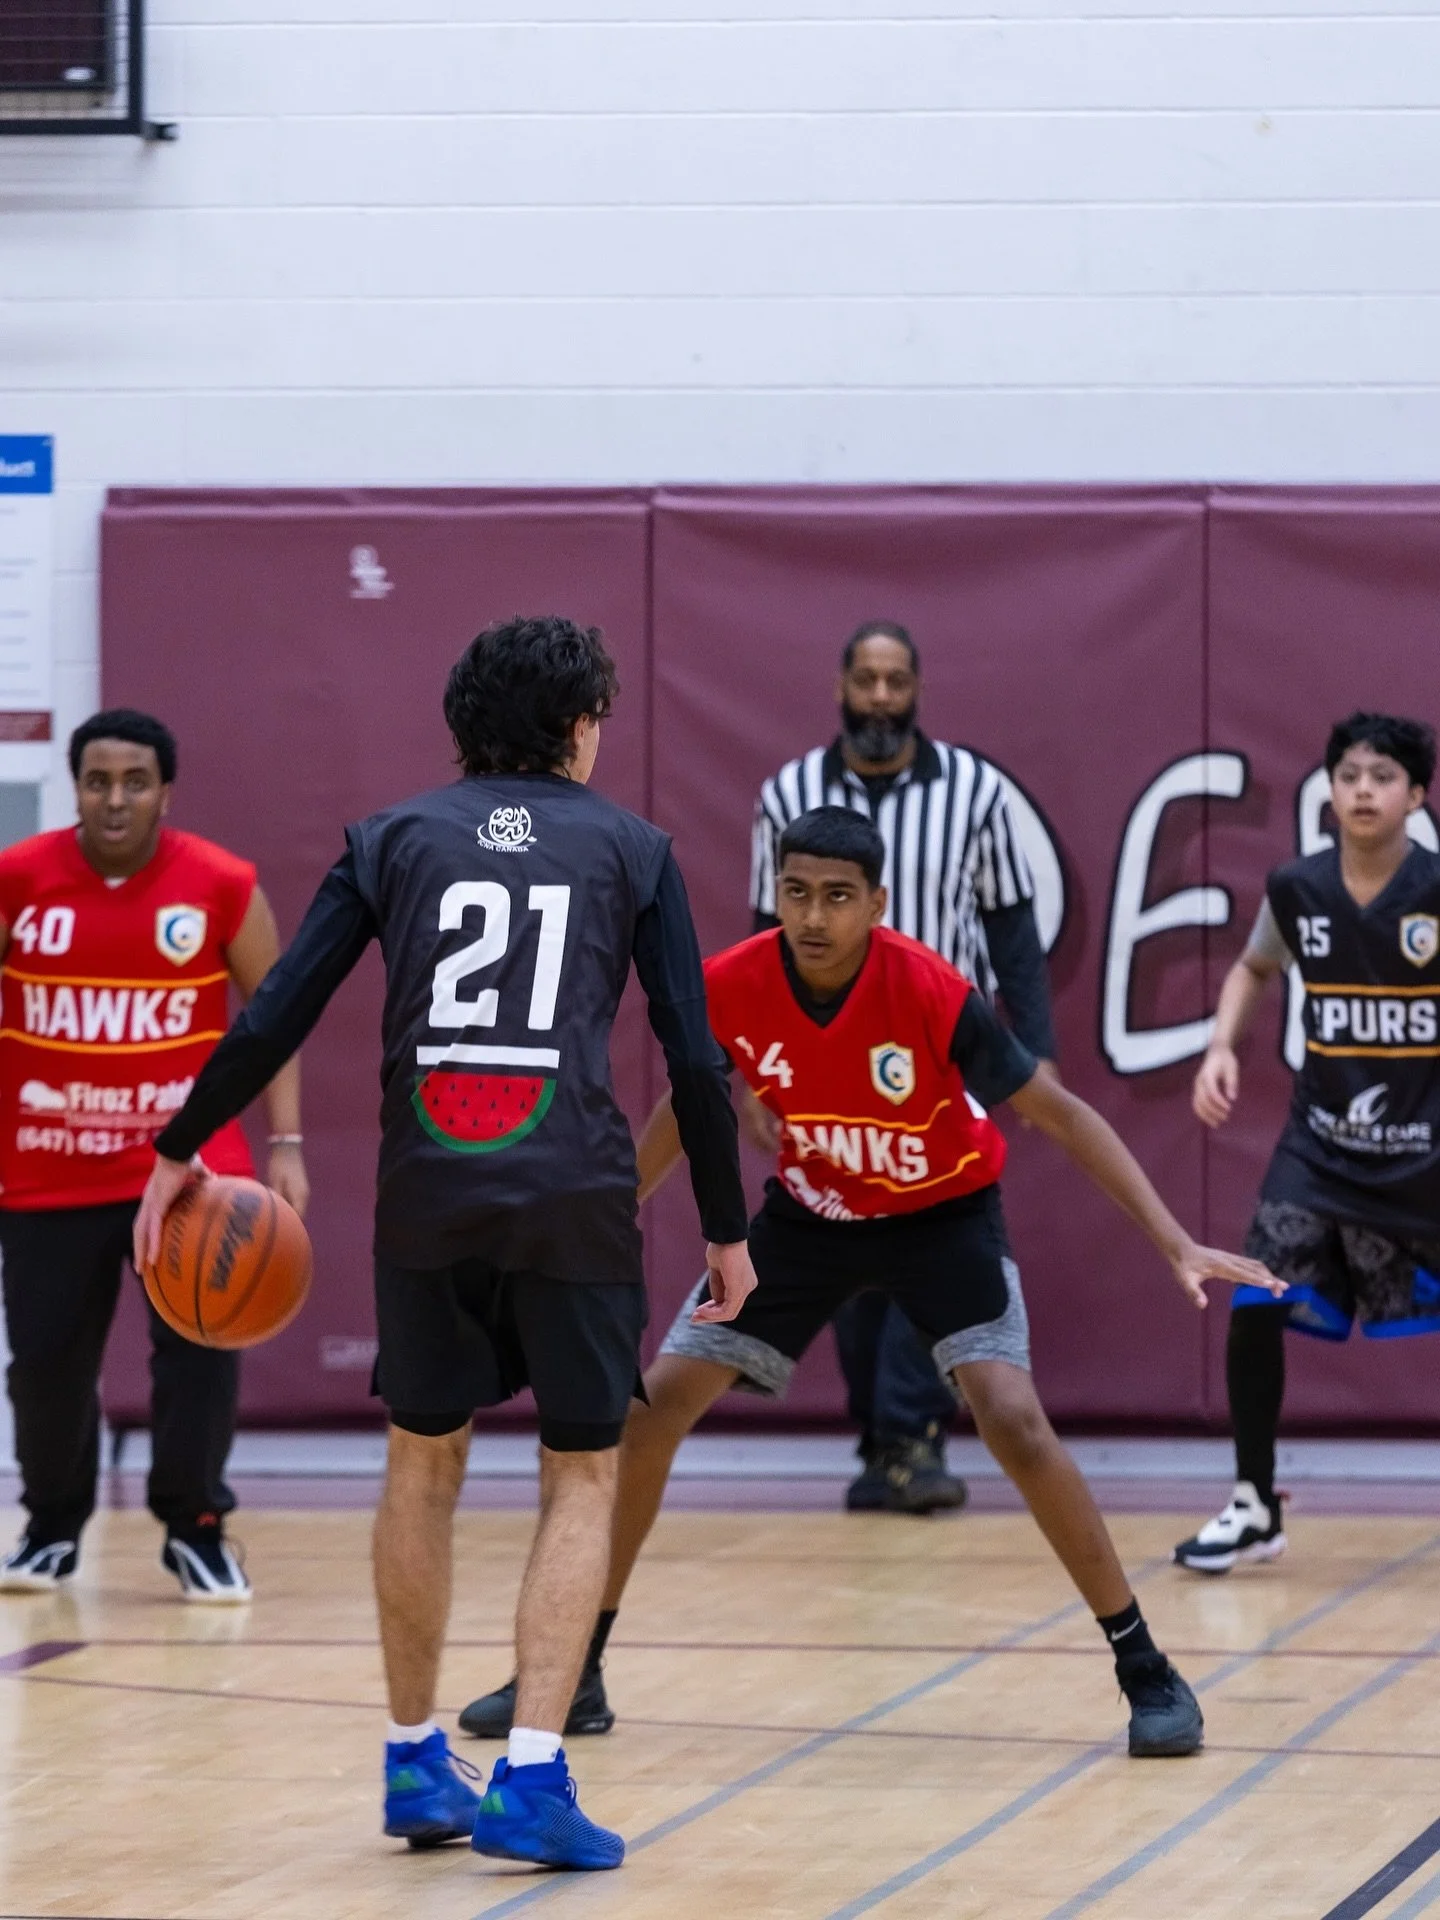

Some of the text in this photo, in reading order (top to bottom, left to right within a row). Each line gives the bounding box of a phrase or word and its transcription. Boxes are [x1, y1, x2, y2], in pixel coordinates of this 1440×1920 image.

[11, 904, 76, 956] 40
[428, 880, 571, 1031] 21
[22, 982, 199, 1042] HAWKS
[1312, 998, 1438, 1043] PURS
[786, 1124, 929, 1183] AWKS
